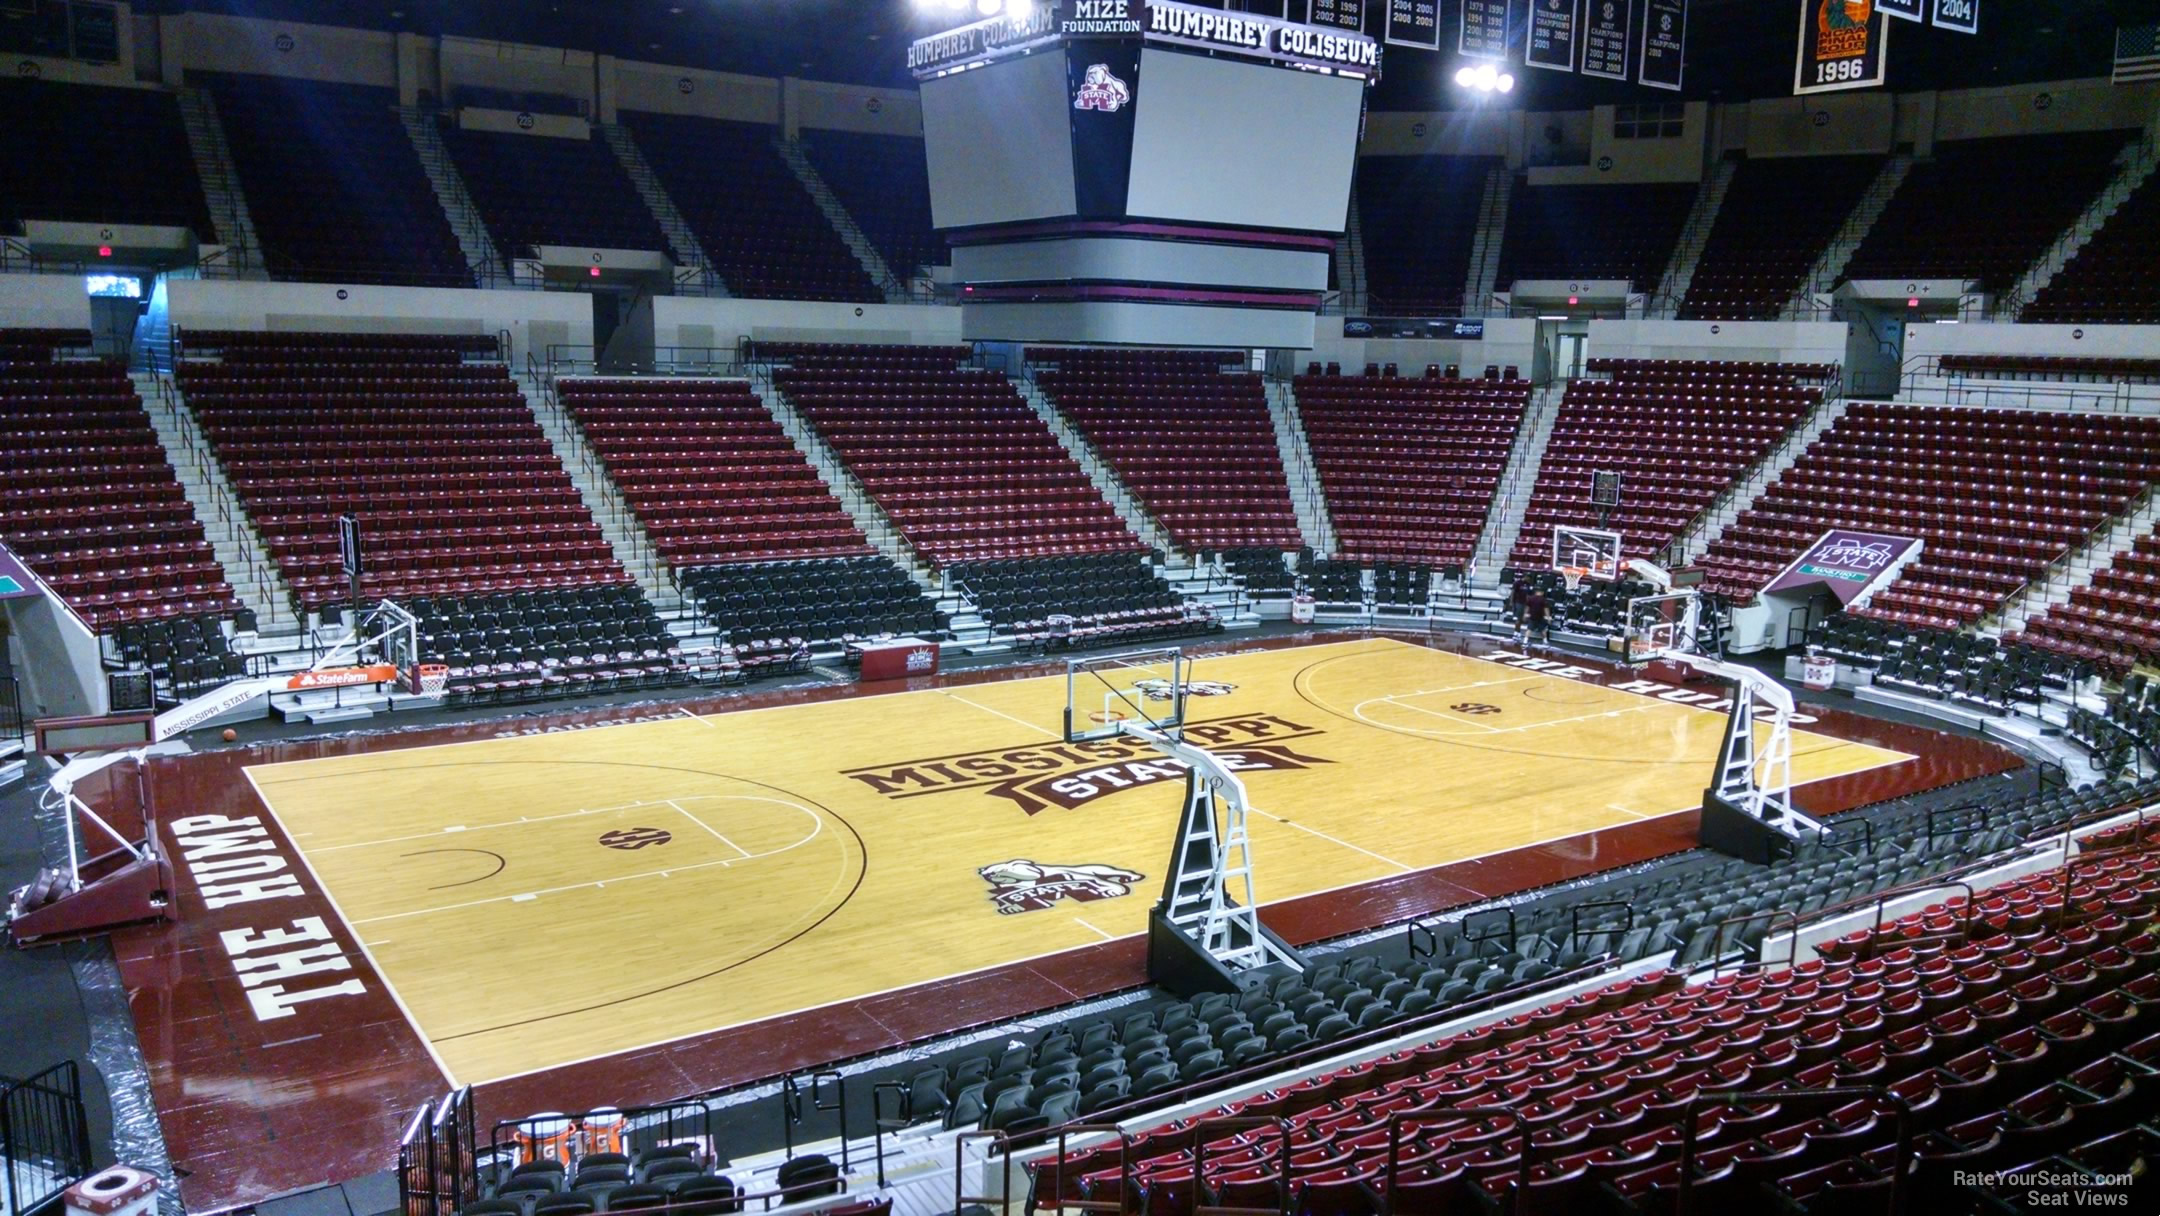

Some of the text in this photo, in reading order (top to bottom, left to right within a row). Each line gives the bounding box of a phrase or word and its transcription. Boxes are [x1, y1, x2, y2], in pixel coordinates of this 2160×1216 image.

[1075, 0, 1128, 18] MIZE
[1315, 10, 1335, 22] 2002
[1941, 0, 1971, 20] 2004
[1062, 20, 1140, 33] FOUNDATION
[1151, 5, 1377, 66] HUMPHREY COLISEUM
[907, 28, 977, 68] HUMPHREY
[1818, 32, 1866, 46] FINAL
[1818, 40, 1866, 54] FOUR
[1816, 59, 1863, 83] 1996
[1831, 548, 1878, 561] STATE
[1478, 651, 1603, 679] THE
[163, 690, 252, 737] MISSISSIPPI STATE
[1009, 881, 1090, 902] STATE
[170, 814, 368, 1022] THE HUMP
